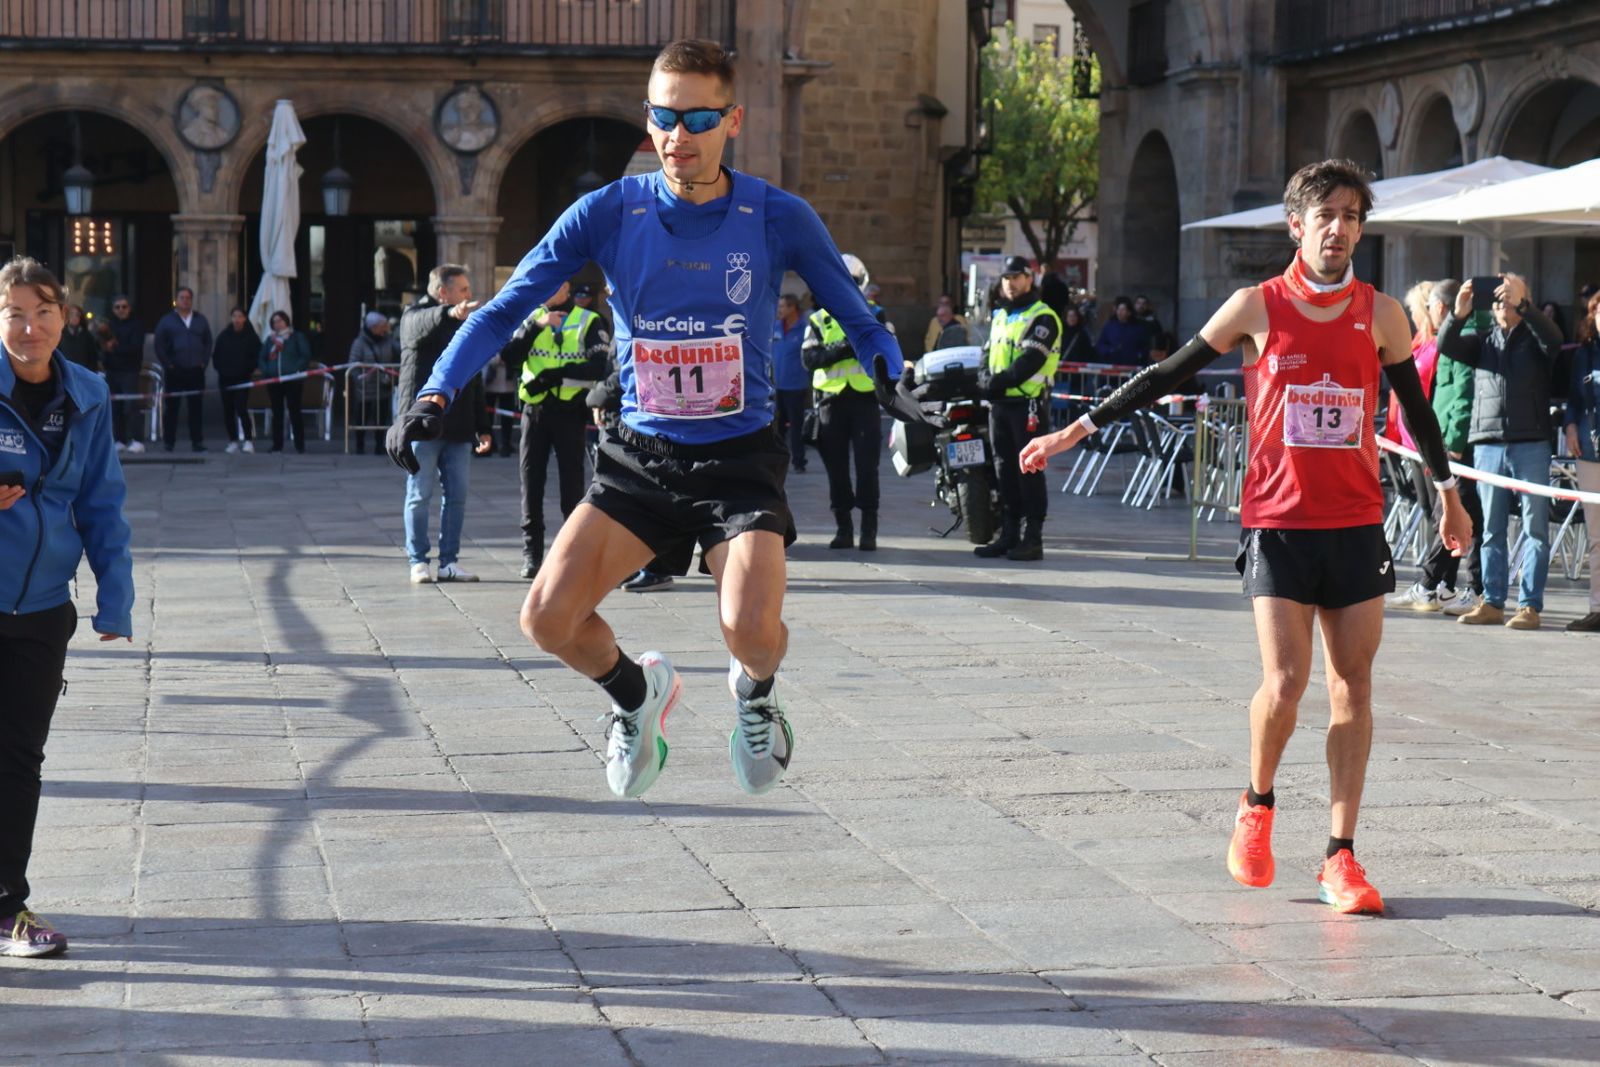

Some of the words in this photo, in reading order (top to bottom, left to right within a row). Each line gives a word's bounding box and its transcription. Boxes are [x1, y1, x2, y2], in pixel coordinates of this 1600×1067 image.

[634, 314, 705, 335] iberCaja
[635, 343, 740, 364] bedunia
[668, 365, 704, 394] 11
[1312, 407, 1342, 429] 13
